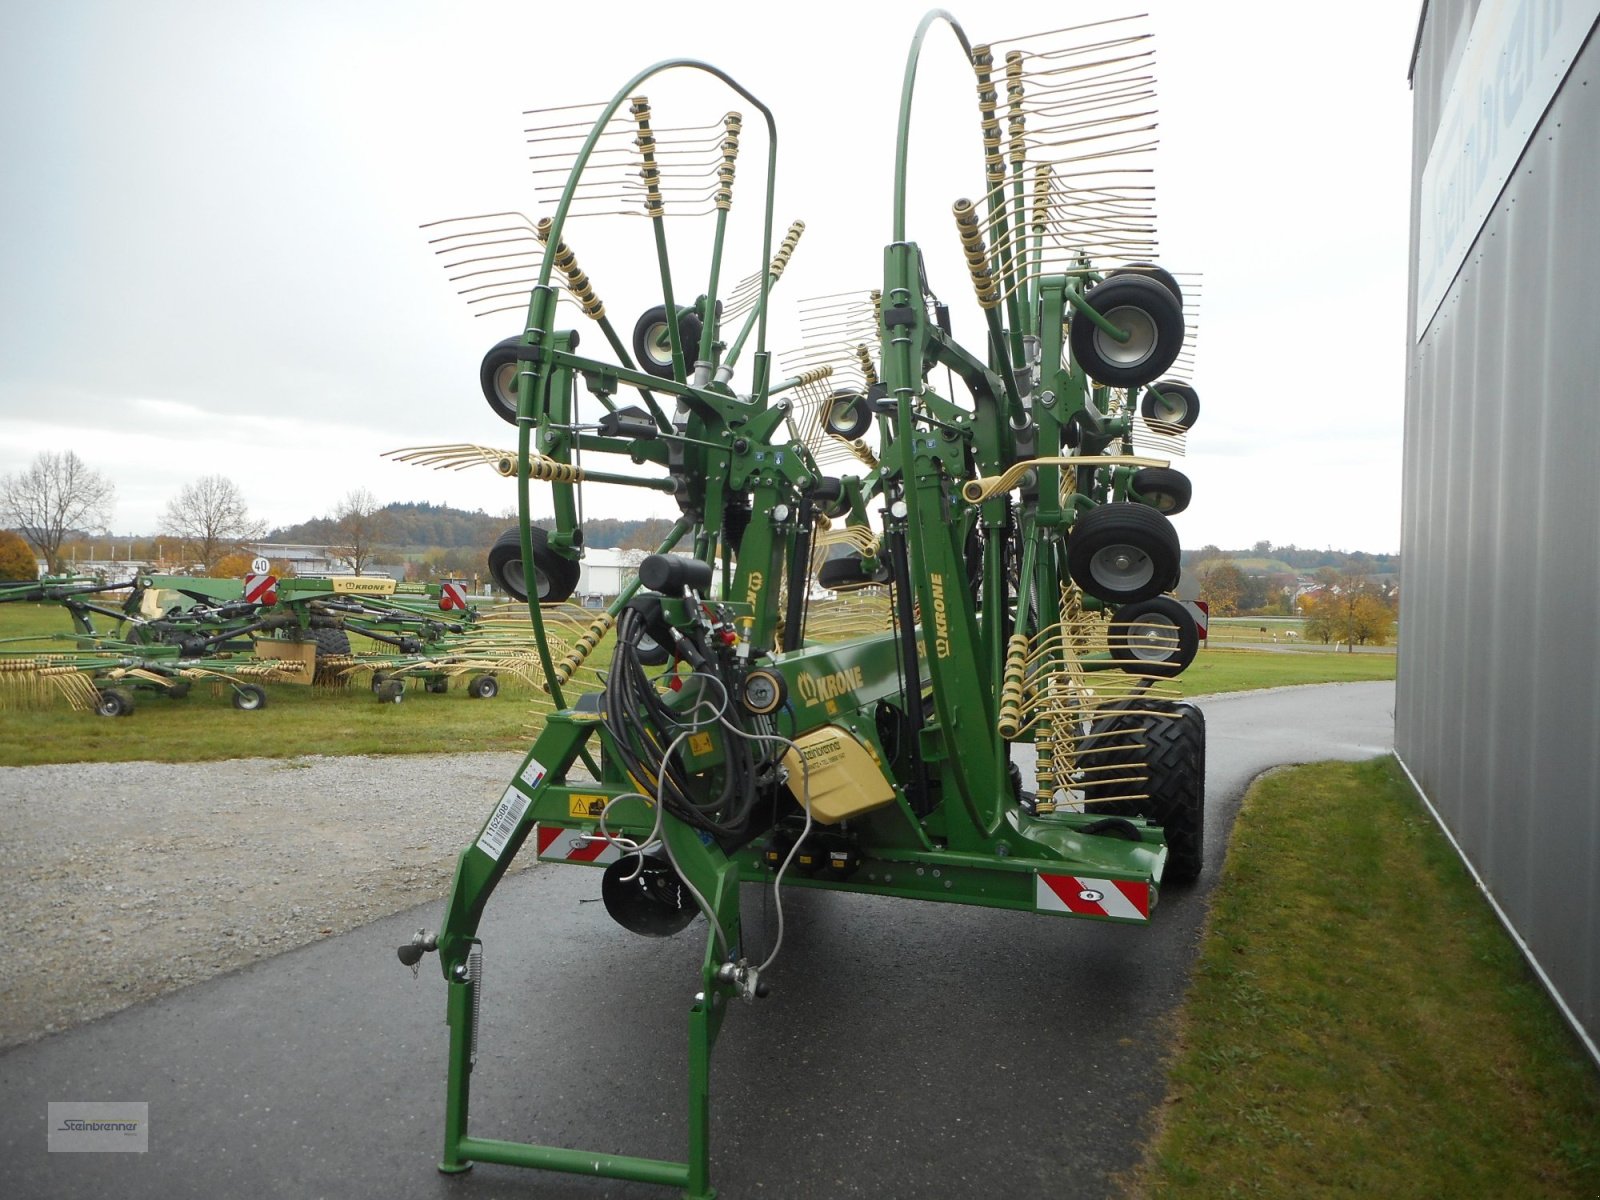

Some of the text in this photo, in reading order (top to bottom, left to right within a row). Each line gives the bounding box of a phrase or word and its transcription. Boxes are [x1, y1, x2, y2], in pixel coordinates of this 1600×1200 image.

[254, 560, 267, 573] 40
[930, 572, 948, 638] KRONE
[816, 666, 864, 703] KRONE
[799, 740, 841, 763] teinbrenner
[485, 803, 509, 838] 1152508
